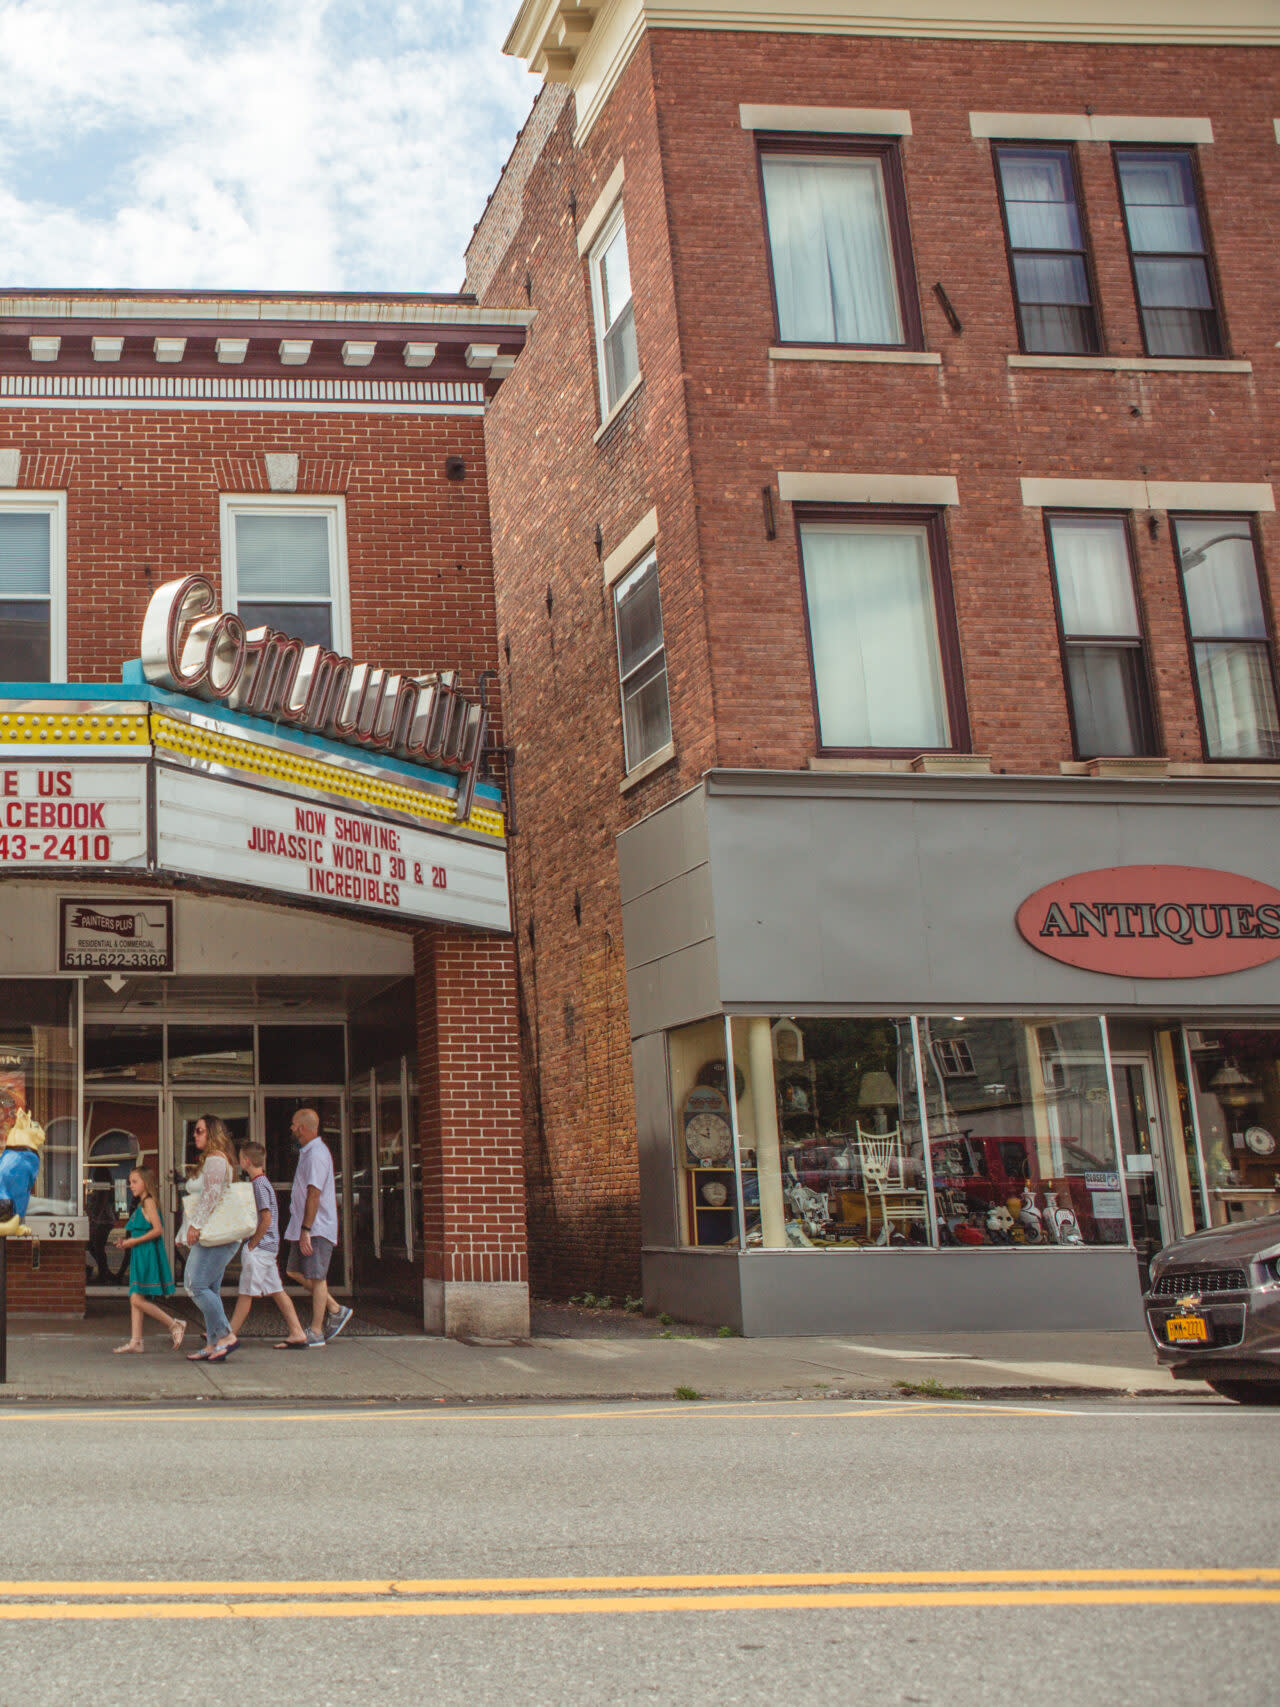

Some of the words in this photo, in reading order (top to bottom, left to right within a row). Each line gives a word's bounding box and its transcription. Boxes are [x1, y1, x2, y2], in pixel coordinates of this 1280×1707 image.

[141, 573, 486, 823] Community
[37, 770, 73, 797] US
[295, 807, 326, 837] NOW
[334, 816, 402, 853] SHOWING:
[247, 826, 324, 864] JURASSIC
[332, 844, 382, 875] WORLD
[389, 856, 406, 881] 3D
[414, 862, 424, 885] &
[431, 866, 448, 889] 2D
[308, 868, 400, 907] INCREDIBLES
[81, 915, 115, 930] PAINTERS
[115, 918, 133, 931] PLUS
[1039, 902, 1280, 945] ANTIQUES
[78, 939, 113, 948] RESIDENTIAL
[119, 939, 155, 948] COMMERCIAL
[49, 1222, 75, 1238] 373
